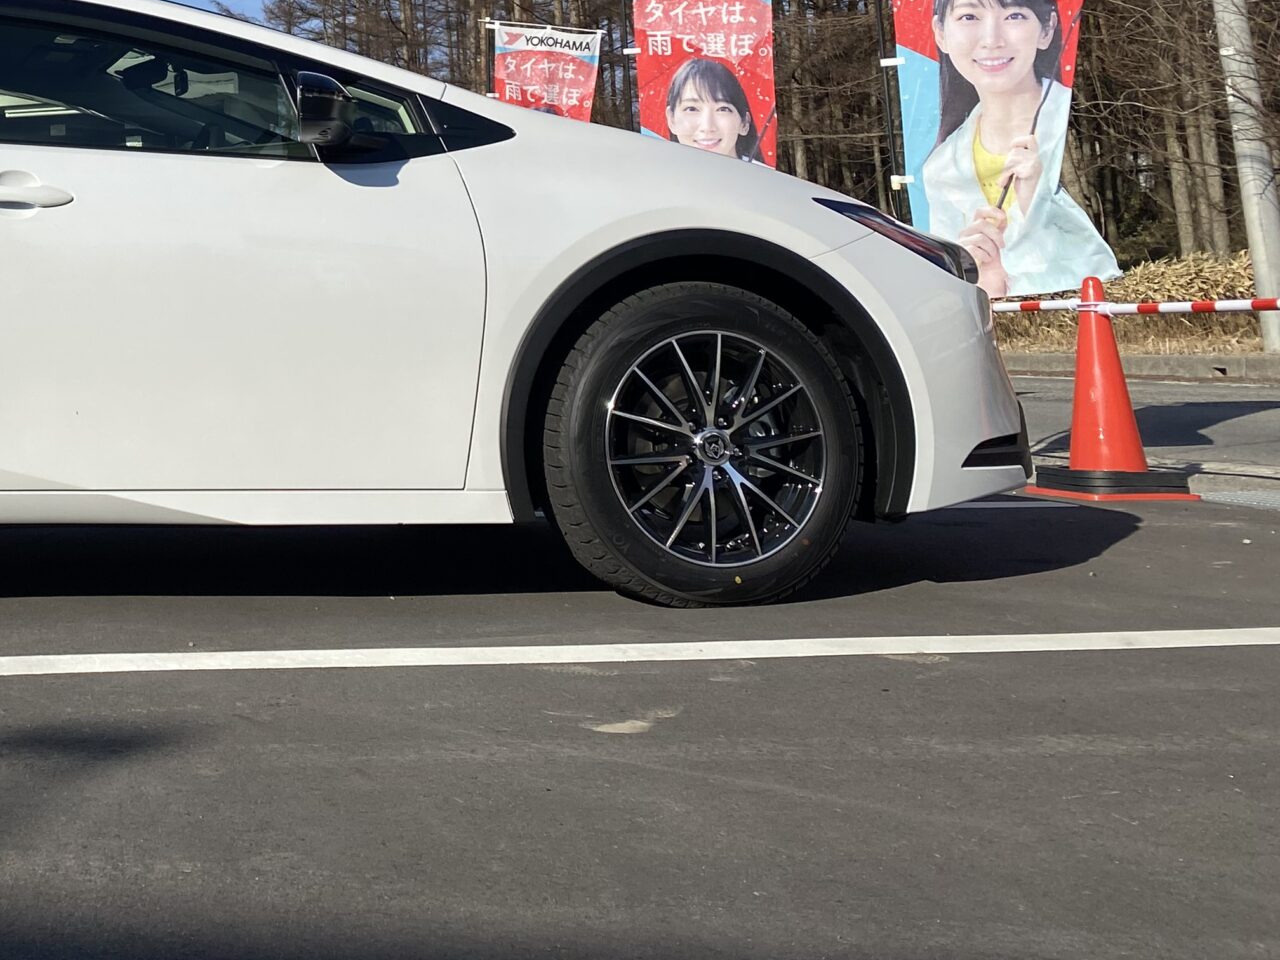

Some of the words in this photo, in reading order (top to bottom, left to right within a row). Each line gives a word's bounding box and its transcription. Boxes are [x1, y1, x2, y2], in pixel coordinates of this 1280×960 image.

[644, 0, 757, 25] タイヤは、
[524, 35, 591, 52] YOKOHAMA
[646, 30, 768, 57] 雨で選ぼ。
